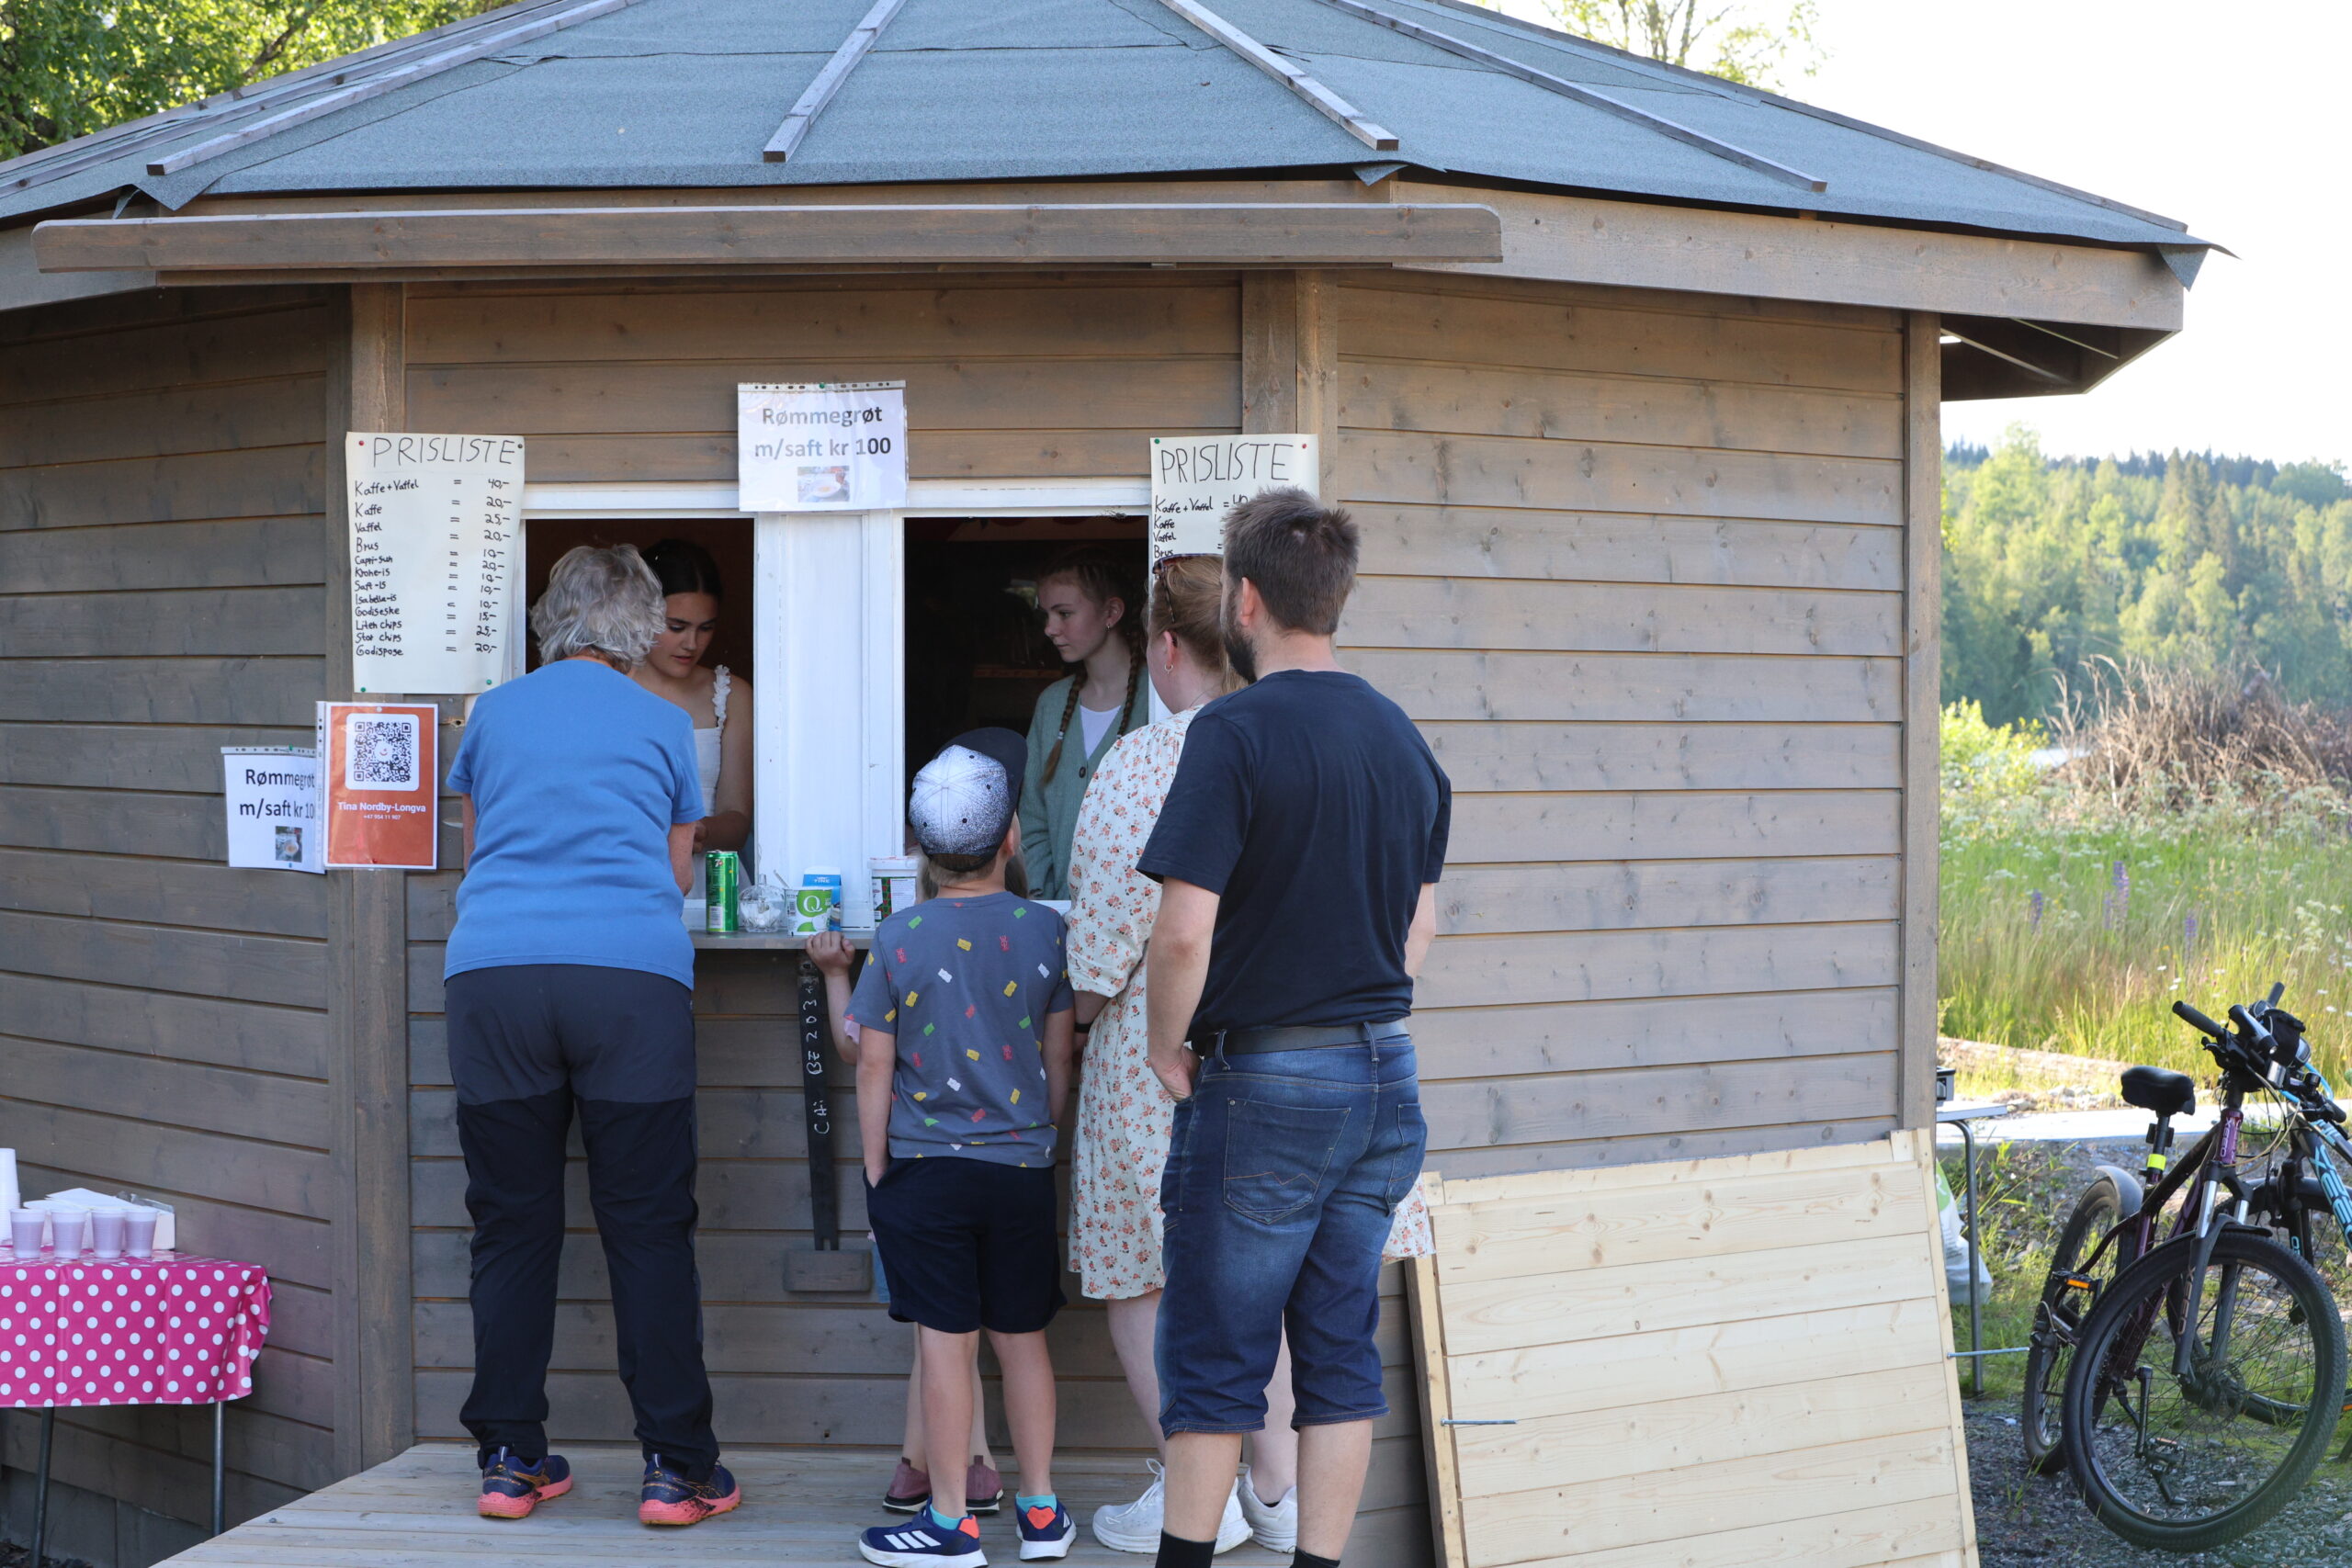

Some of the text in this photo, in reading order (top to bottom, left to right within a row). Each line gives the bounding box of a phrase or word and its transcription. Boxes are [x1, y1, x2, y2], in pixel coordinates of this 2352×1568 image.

[763, 406, 882, 427] Rømmegrøt
[373, 436, 515, 468] PRISLISTE
[754, 437, 891, 459] m/saft kr 100
[1160, 442, 1294, 484] PRISLISTE
[355, 479, 385, 497] Kaffe
[393, 479, 419, 491] Vaffel
[355, 502, 382, 518] Kaffe
[1155, 494, 1182, 513] Kaffe
[1189, 496, 1214, 512] Vaffel
[355, 522, 382, 533] Vaffel
[1153, 514, 1175, 530] Kaffe
[356, 536, 379, 553] Brus
[1153, 530, 1177, 542] Vaffel
[1154, 544, 1174, 559] Brus
[356, 619, 378, 630] Liten
[379, 618, 402, 631] chips
[356, 632, 374, 644] Stor
[379, 631, 401, 642] chips
[356, 644, 403, 658] Godispose
[245, 769, 315, 791] Rømmegrøt
[240, 798, 291, 819] m/saft
[293, 805, 303, 818] kr
[338, 801, 426, 814] Tina Nordby-Longva
[803, 896, 823, 913] Q
